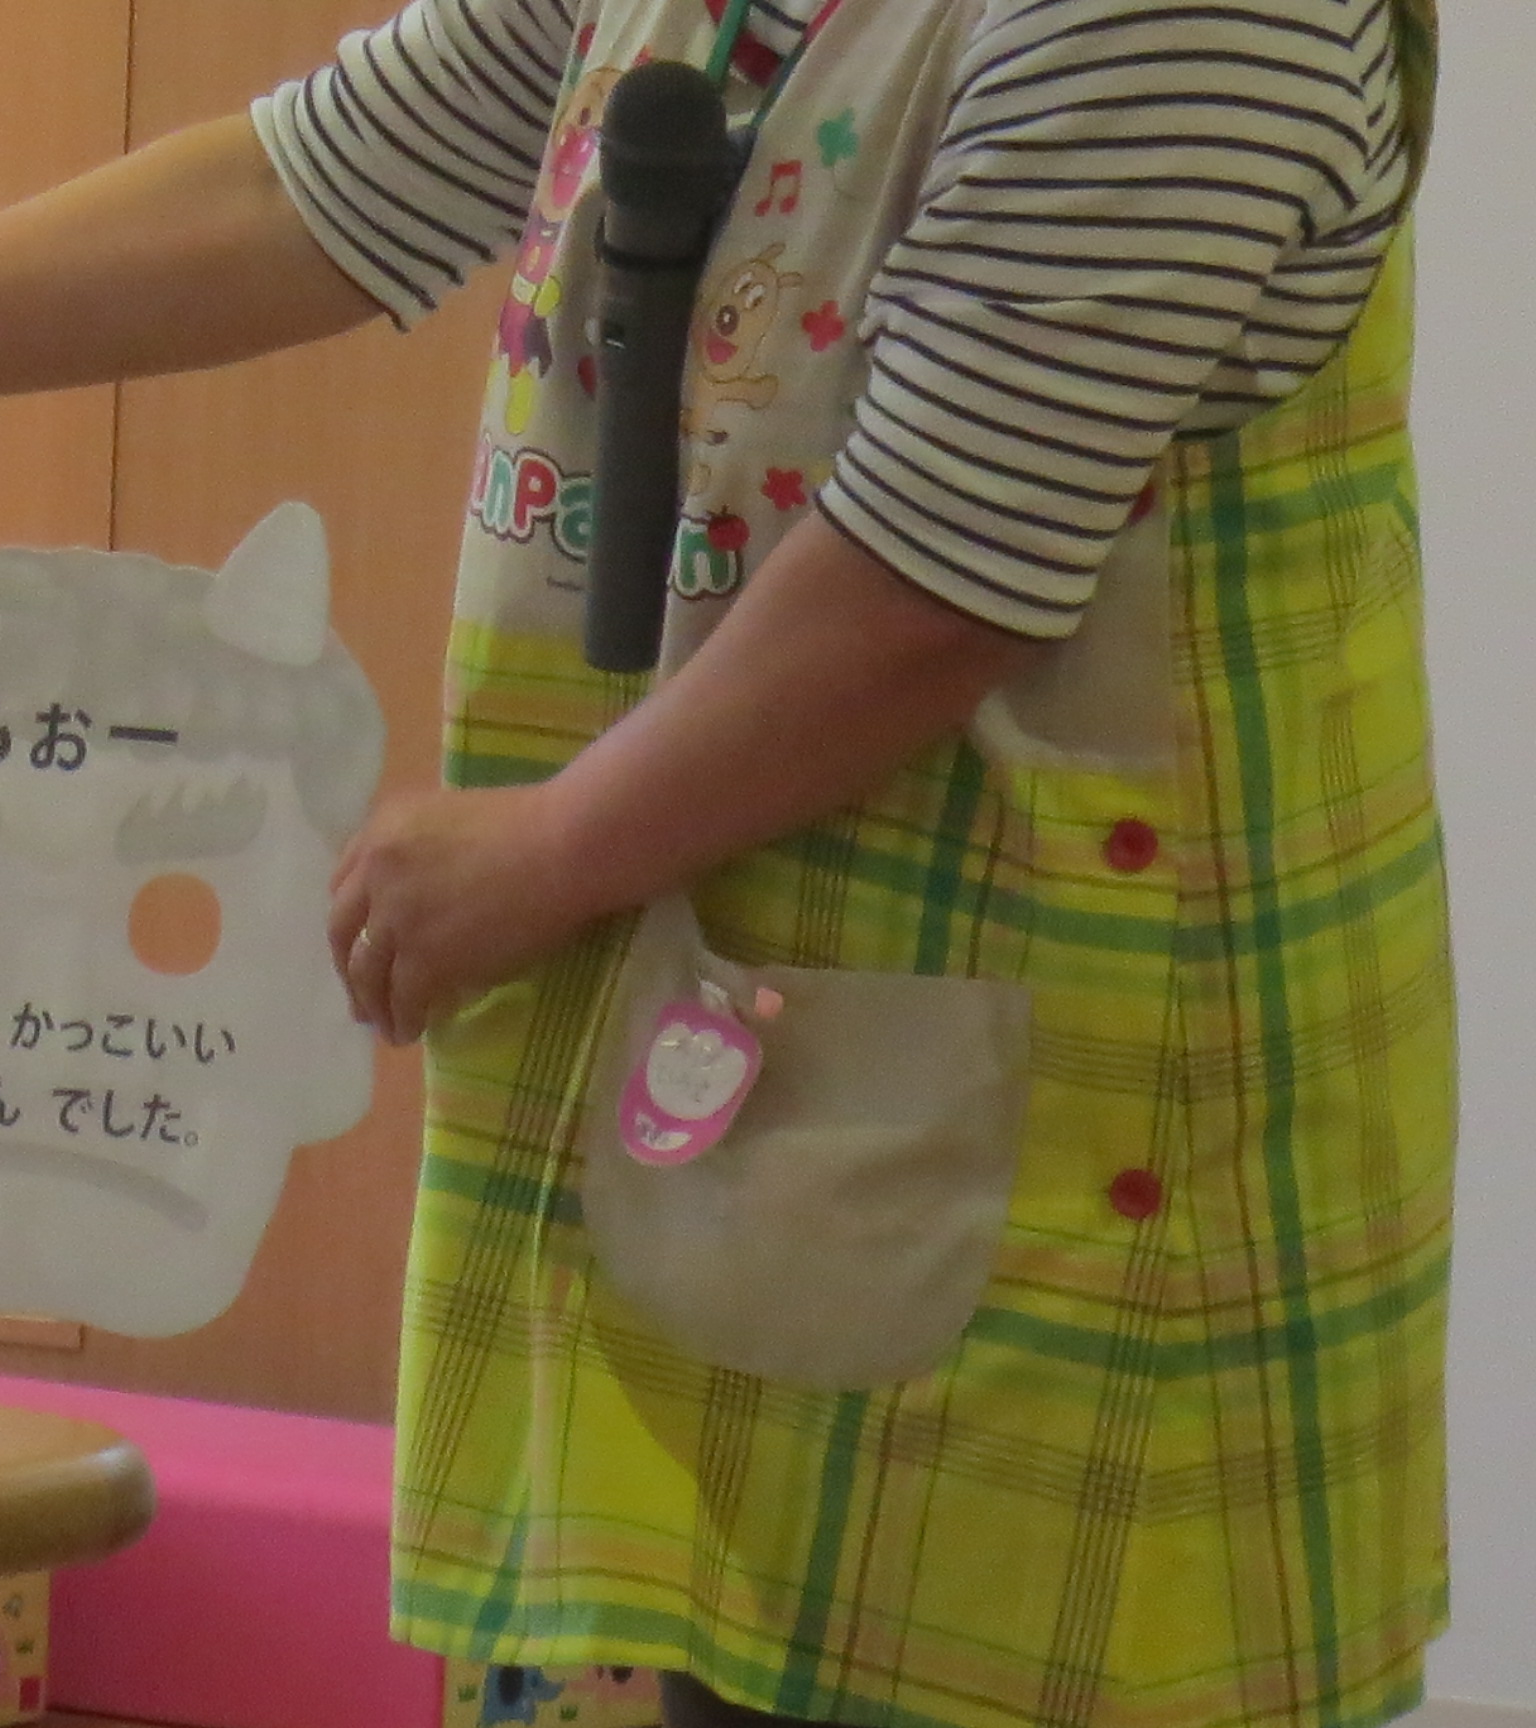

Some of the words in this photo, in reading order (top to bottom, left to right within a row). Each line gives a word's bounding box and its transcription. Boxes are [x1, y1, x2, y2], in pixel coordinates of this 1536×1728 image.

[11, 1002, 236, 1065] かっこいい
[52, 1087, 198, 1147] でした。
